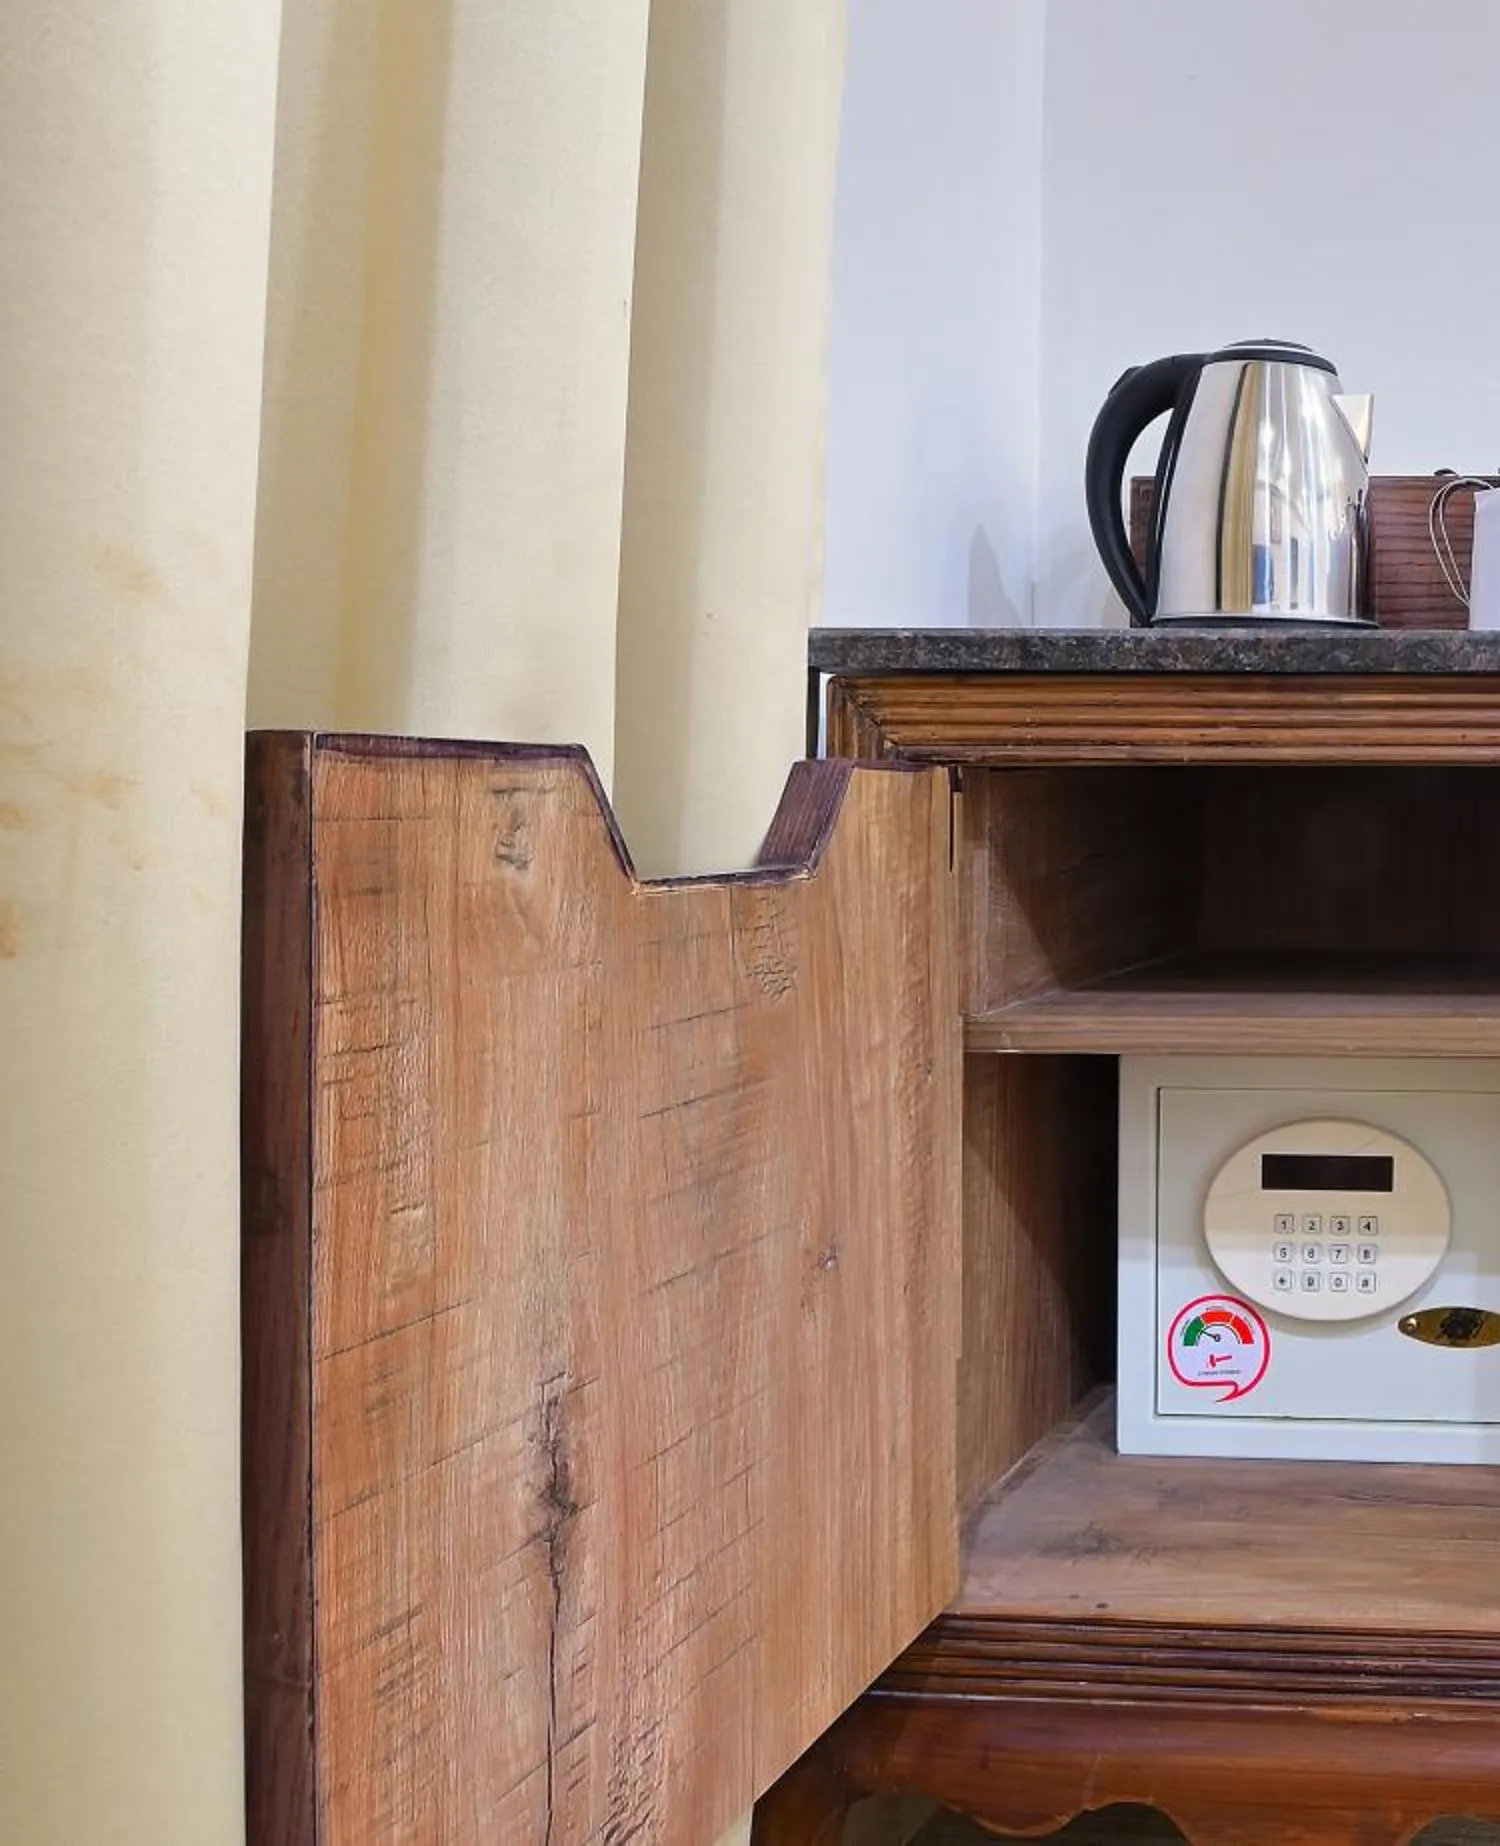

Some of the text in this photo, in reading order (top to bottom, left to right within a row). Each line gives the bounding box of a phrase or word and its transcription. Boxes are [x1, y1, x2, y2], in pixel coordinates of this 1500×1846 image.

[1308, 1220, 1316, 1231] 2
[1337, 1220, 1344, 1231] 3
[1363, 1221, 1371, 1231] 4
[1280, 1247, 1287, 1259] 5
[1307, 1247, 1315, 1259] 6
[1335, 1249, 1342, 1259] 7
[1334, 1277, 1342, 1288] 0
